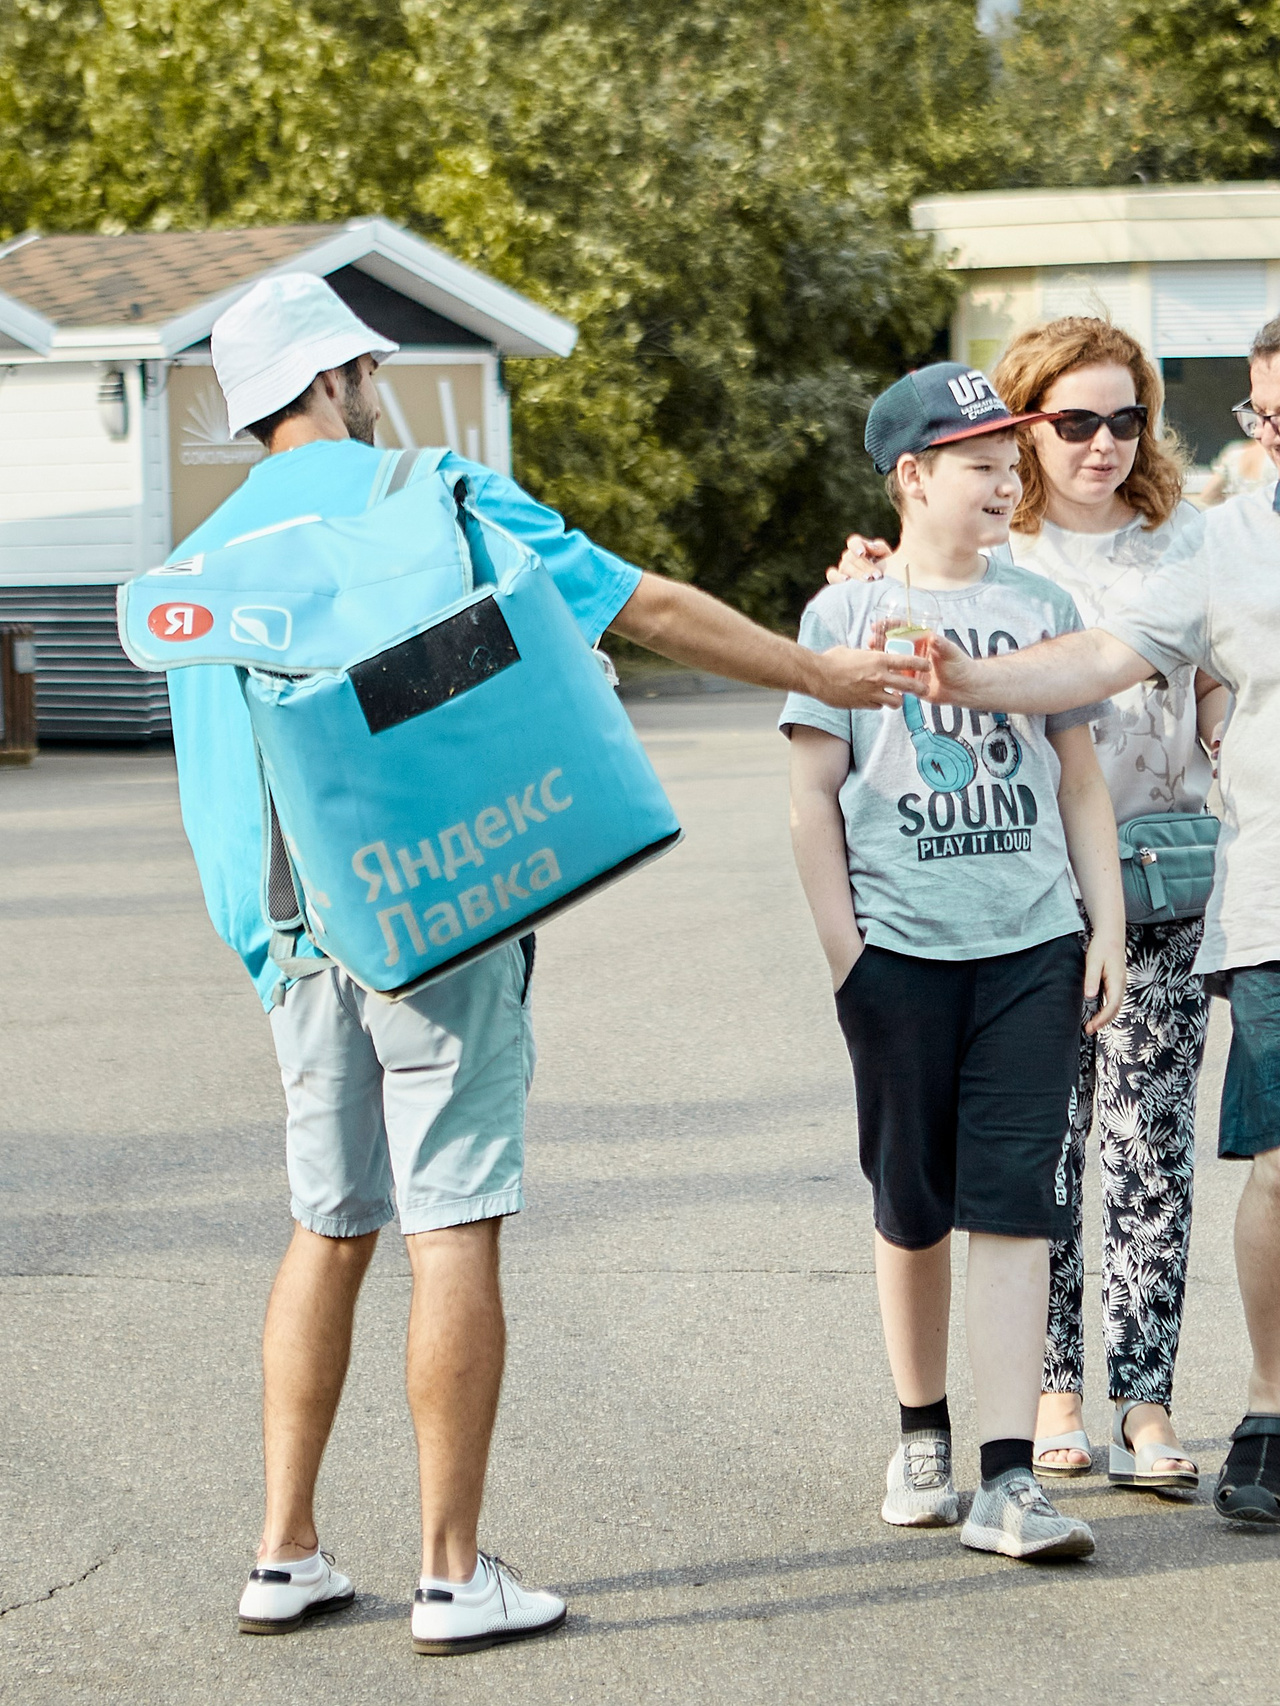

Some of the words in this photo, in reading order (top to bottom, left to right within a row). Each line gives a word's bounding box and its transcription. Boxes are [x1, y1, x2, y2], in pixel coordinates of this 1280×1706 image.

[164, 607, 194, 635] Я
[351, 767, 574, 904] Яндекс
[897, 784, 1038, 837] SOUND
[919, 837, 966, 859] PLAY
[972, 834, 988, 854] IT
[993, 832, 1030, 851] LOUD
[375, 848, 563, 967] Лавка
